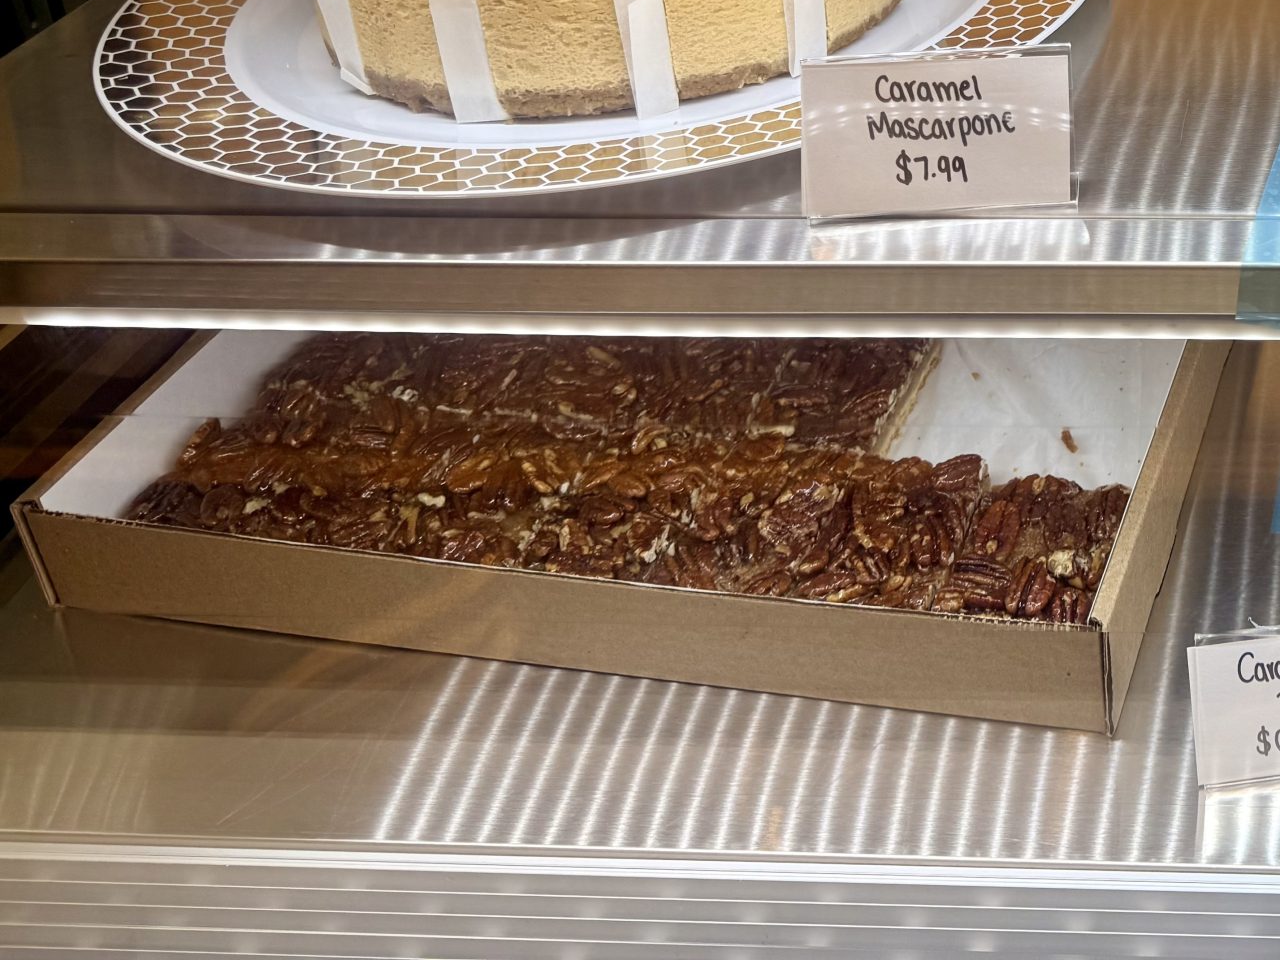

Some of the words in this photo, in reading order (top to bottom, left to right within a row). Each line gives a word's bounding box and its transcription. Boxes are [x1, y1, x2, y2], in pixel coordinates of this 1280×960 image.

[875, 74, 982, 104] Caramel
[866, 111, 1016, 146] Mascarpone
[895, 149, 968, 185] $7.99
